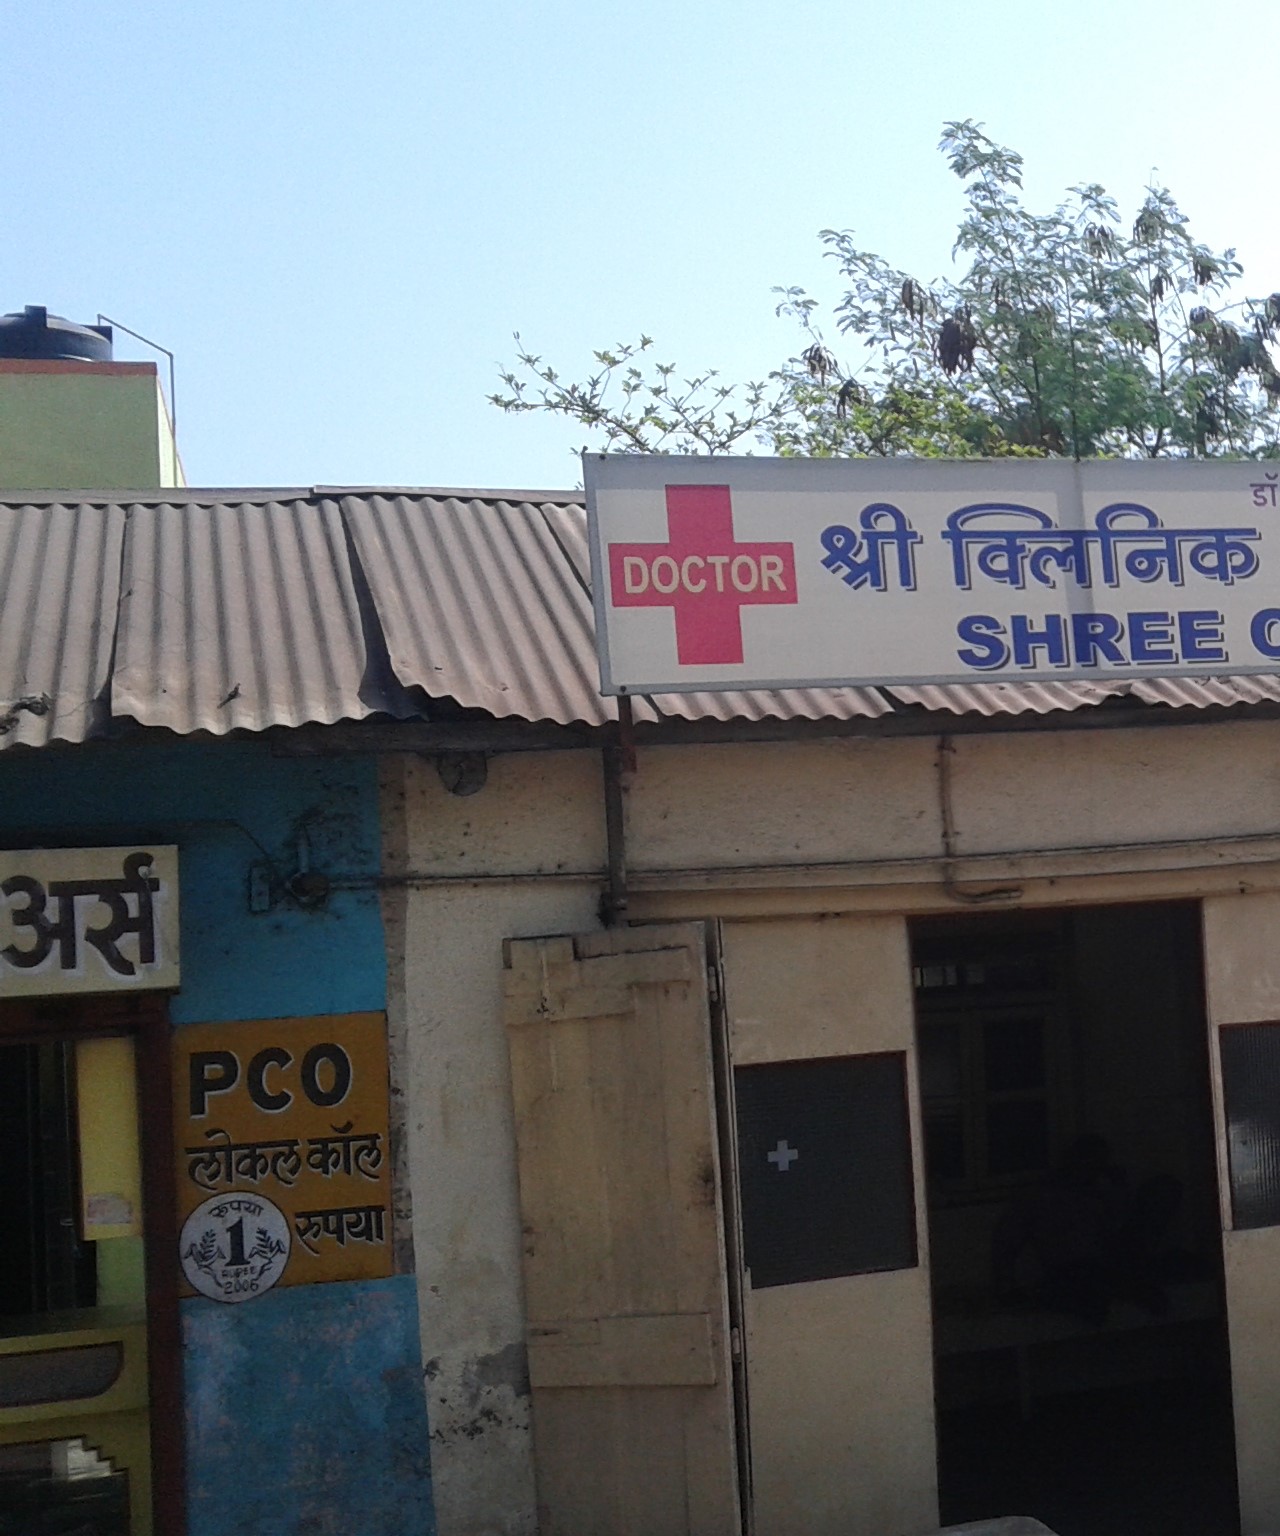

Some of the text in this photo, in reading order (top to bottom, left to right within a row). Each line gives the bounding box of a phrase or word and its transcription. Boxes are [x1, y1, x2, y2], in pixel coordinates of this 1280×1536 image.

[624, 555, 787, 594] DOCTOR
[820, 503, 1261, 592] श्री क्लिनिक
[956, 610, 1230, 671] SHREE
[189, 1042, 353, 1119] PCO
[185, 1120, 383, 1191] लोकल कॉल
[225, 1216, 251, 1266] 1
